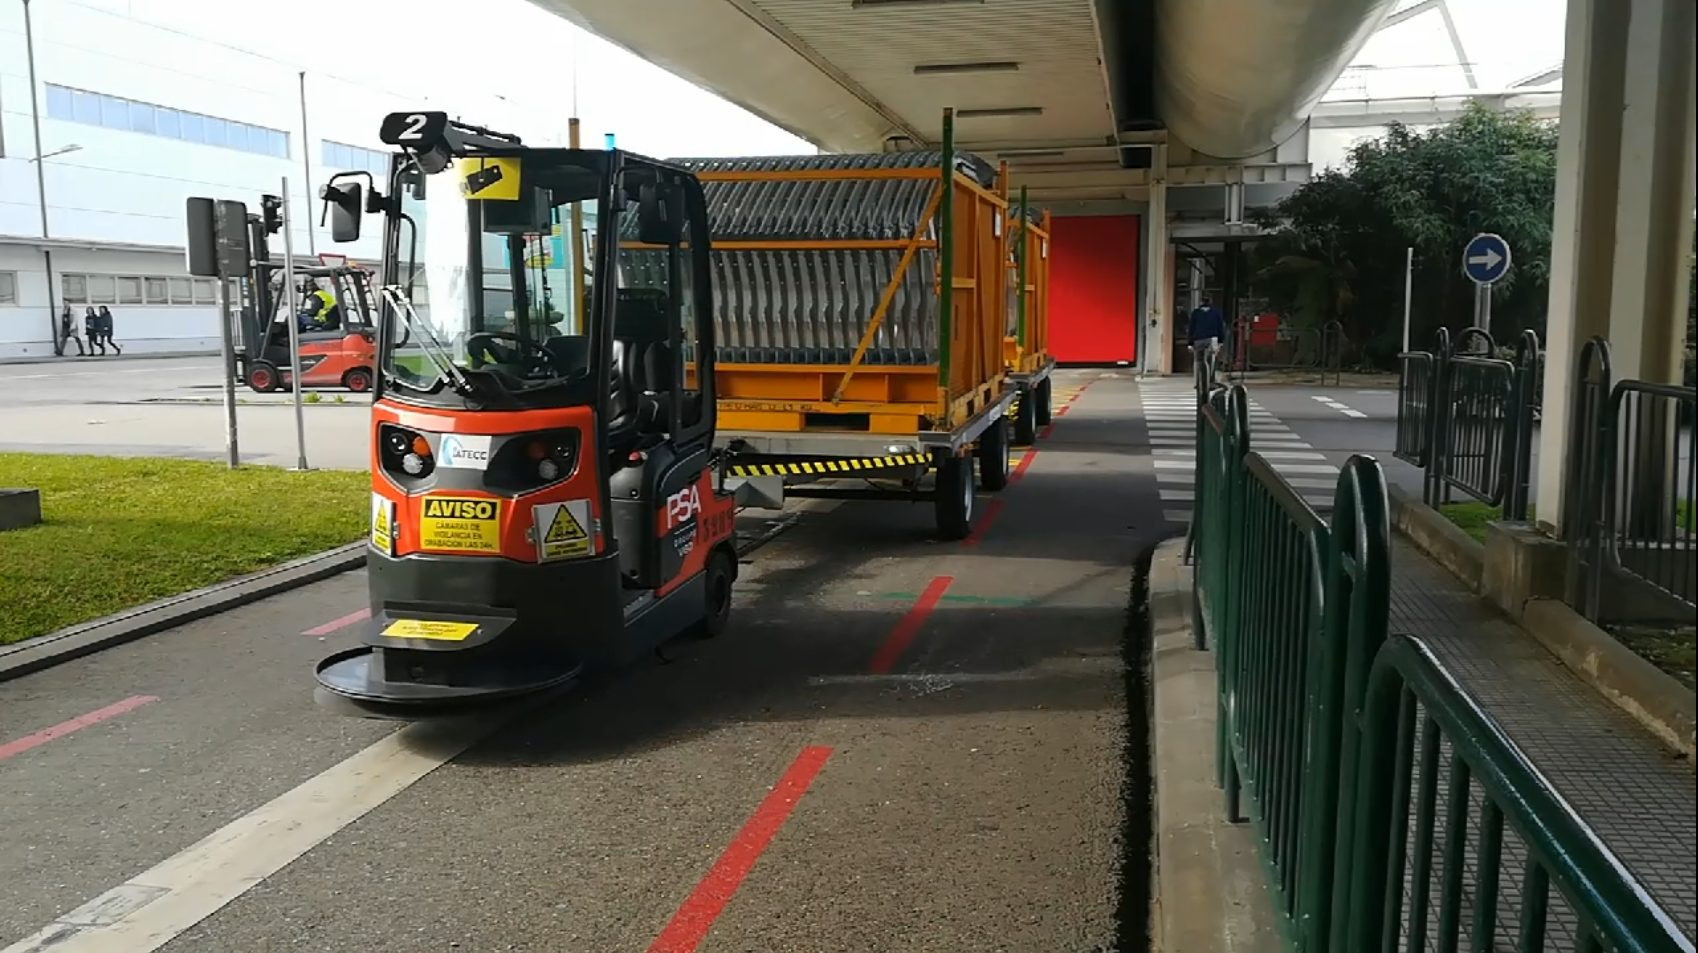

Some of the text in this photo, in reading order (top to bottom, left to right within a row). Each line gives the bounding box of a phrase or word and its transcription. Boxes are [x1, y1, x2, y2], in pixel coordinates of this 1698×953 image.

[398, 114, 428, 140] 2
[427, 500, 493, 519] AVISO
[667, 485, 702, 529] PSA
